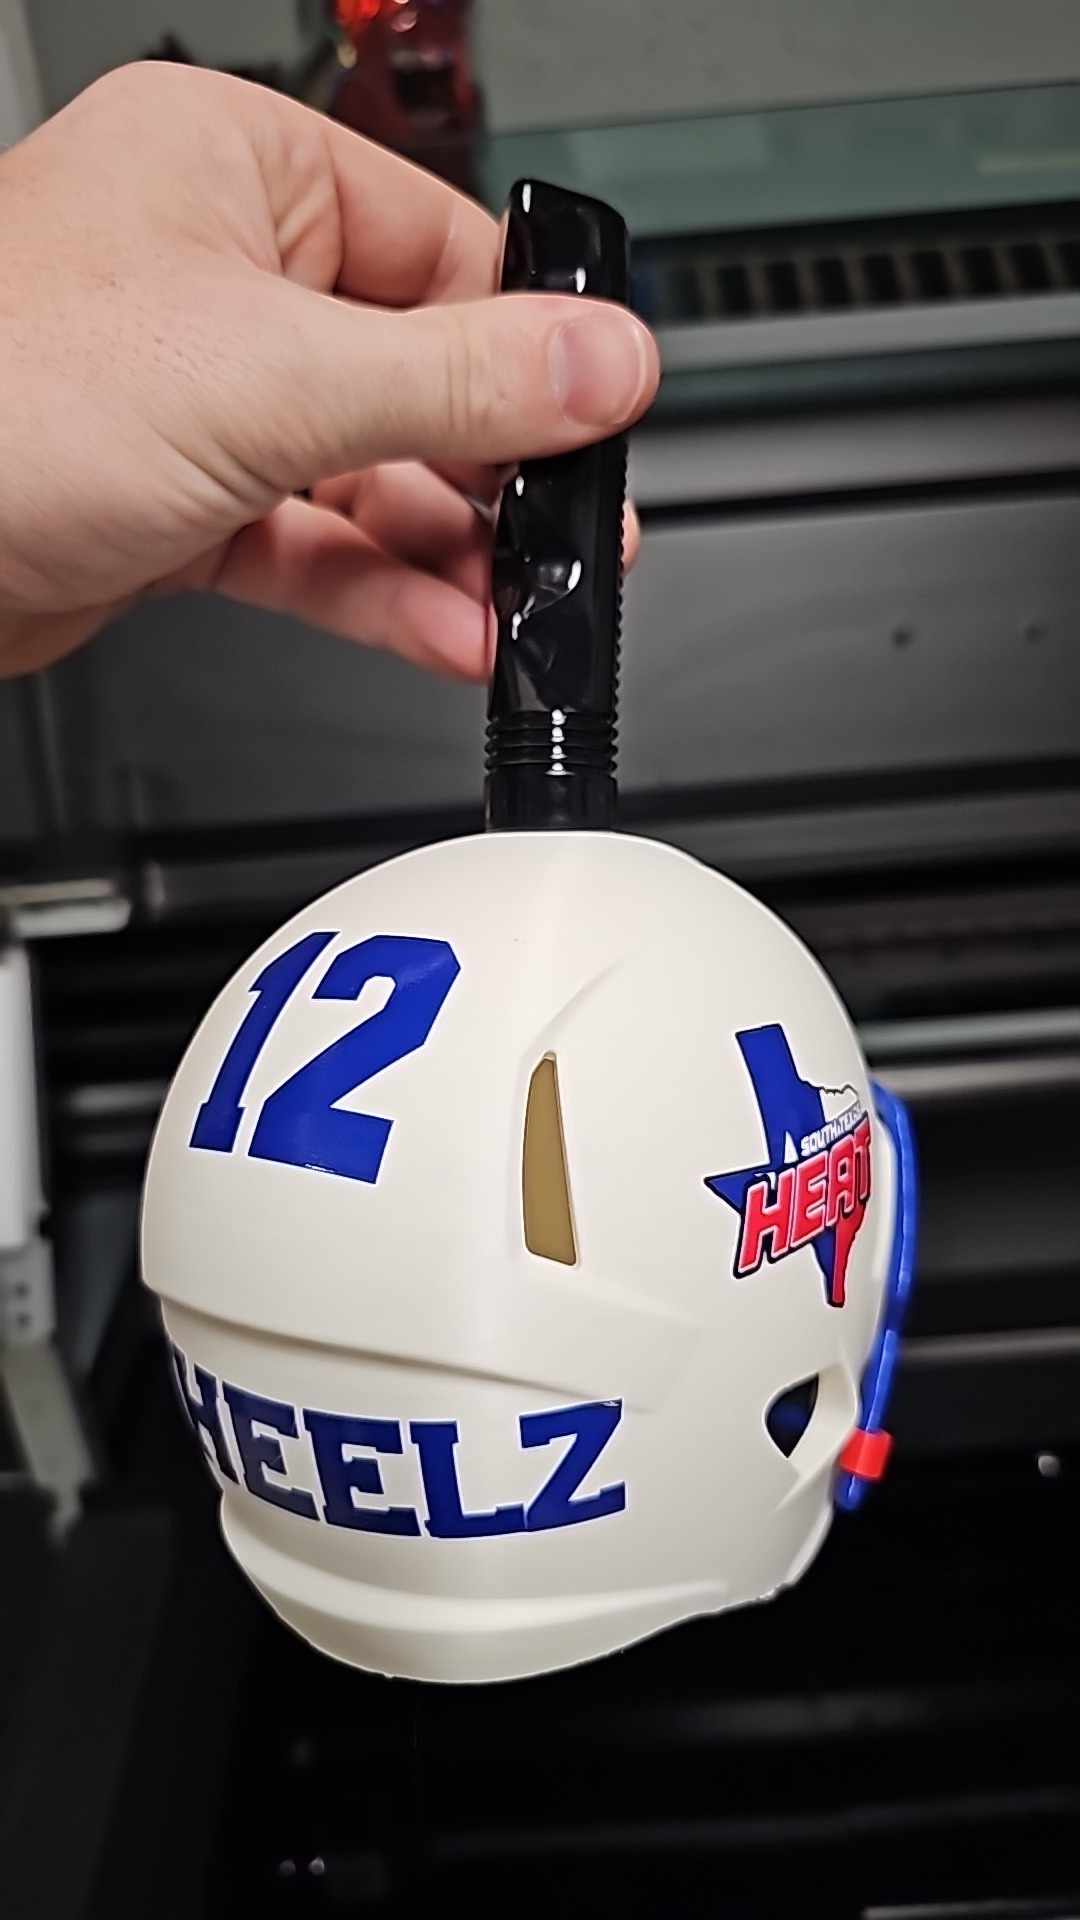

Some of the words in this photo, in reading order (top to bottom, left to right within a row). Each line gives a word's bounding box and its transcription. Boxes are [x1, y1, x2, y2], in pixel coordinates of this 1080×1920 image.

[189, 931, 461, 1184] 12
[801, 1119, 839, 1156] SOUTH
[737, 1113, 872, 1275] HEAT
